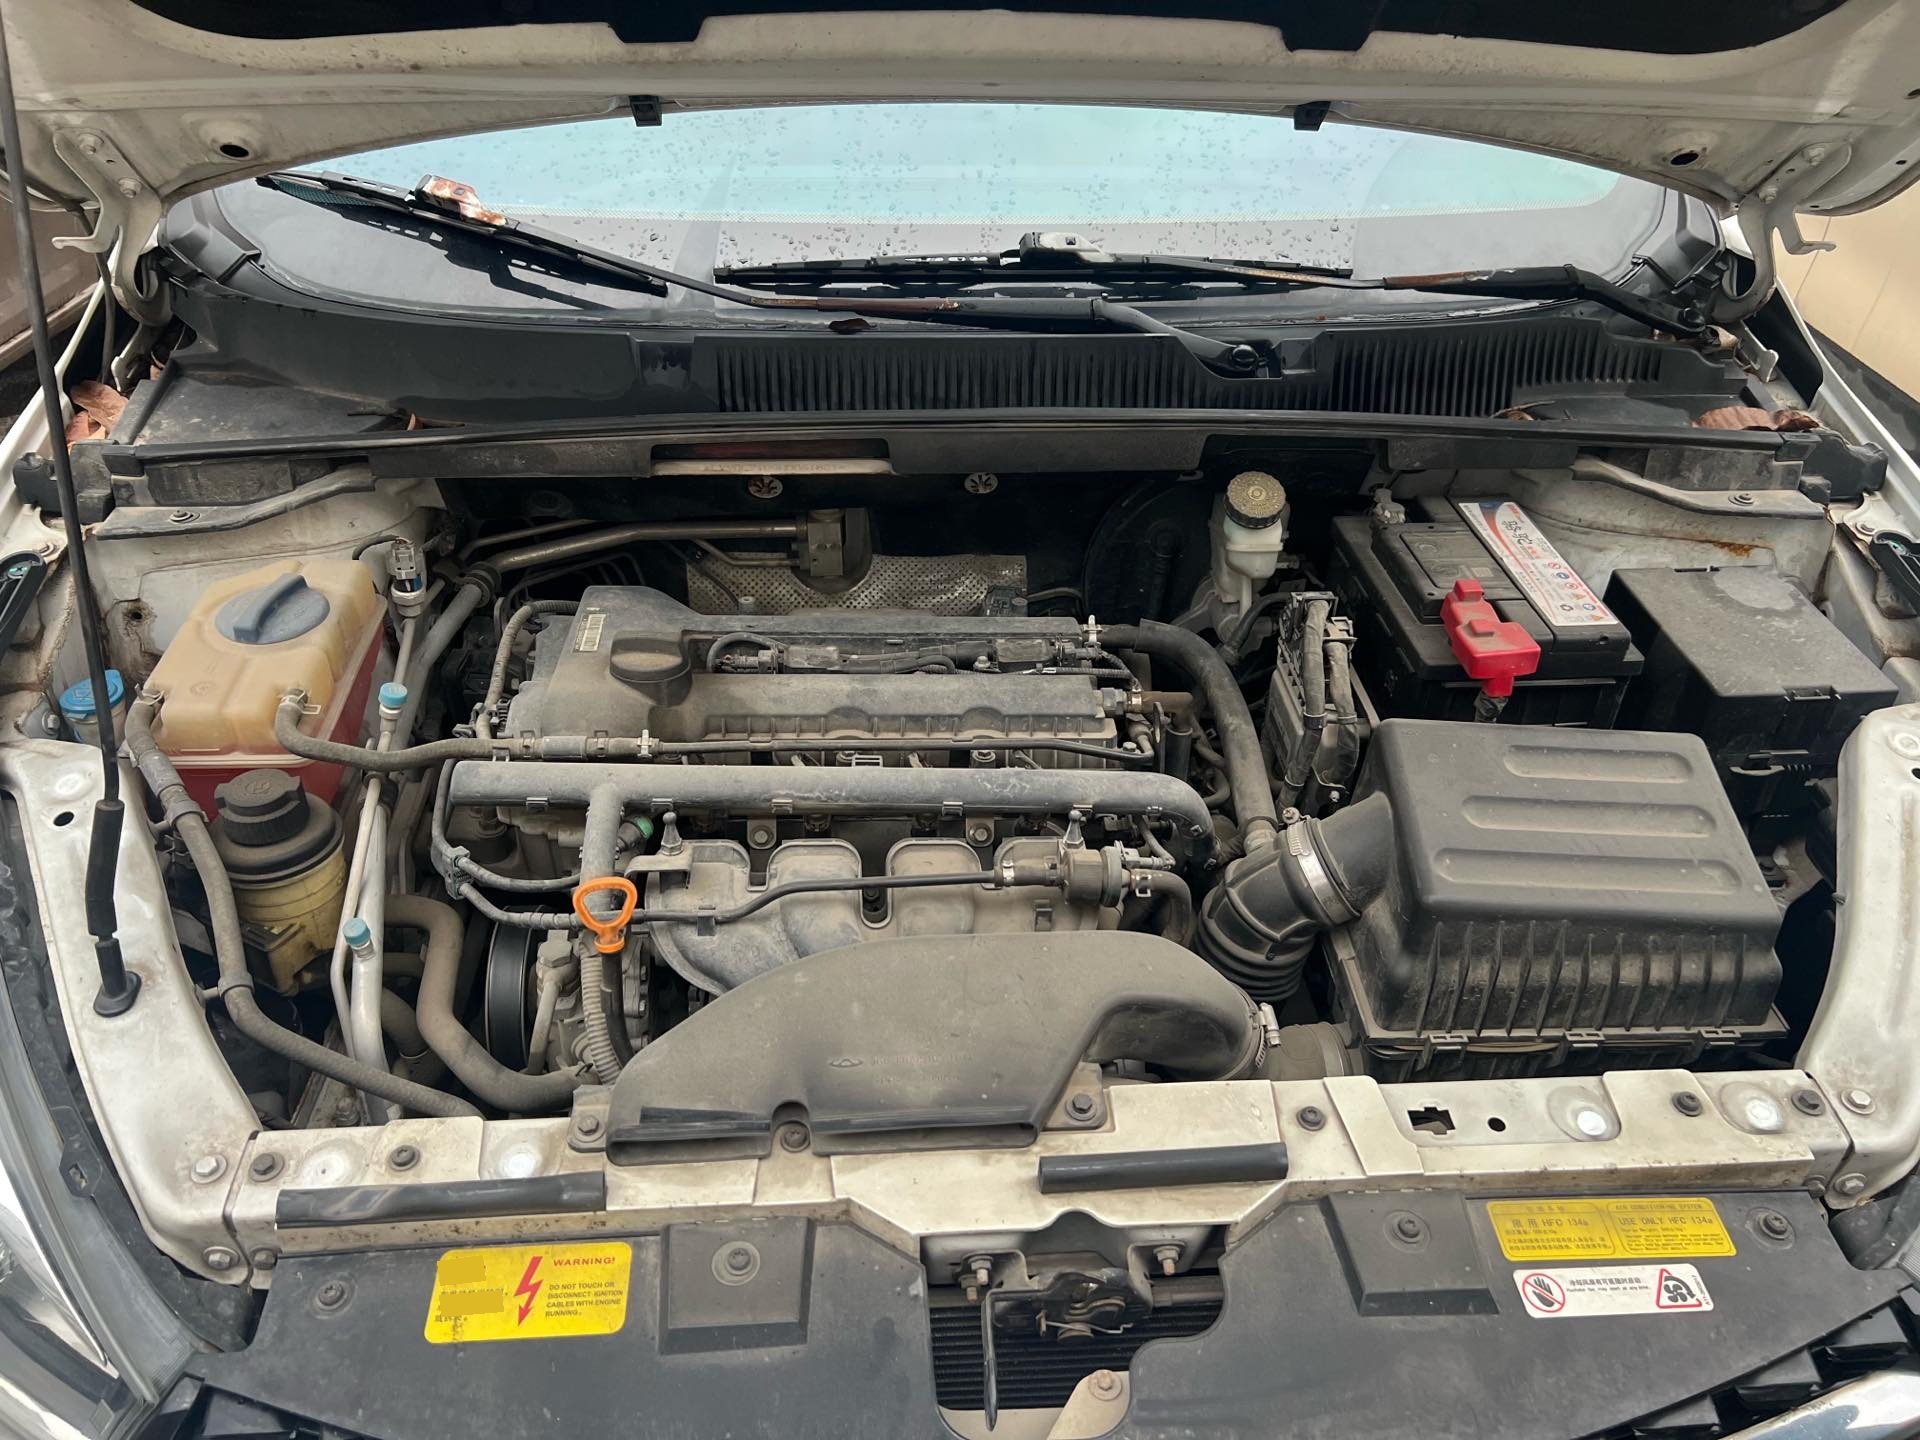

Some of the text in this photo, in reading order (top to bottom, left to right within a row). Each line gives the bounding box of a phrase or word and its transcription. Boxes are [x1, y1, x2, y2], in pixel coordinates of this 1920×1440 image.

[1542, 1218, 1564, 1227] HFC
[1619, 1215, 1713, 1226] USE ONLY HFC 134a
[553, 1257, 616, 1267] WARNING!
[548, 1291, 591, 1299] DISCONNECT
